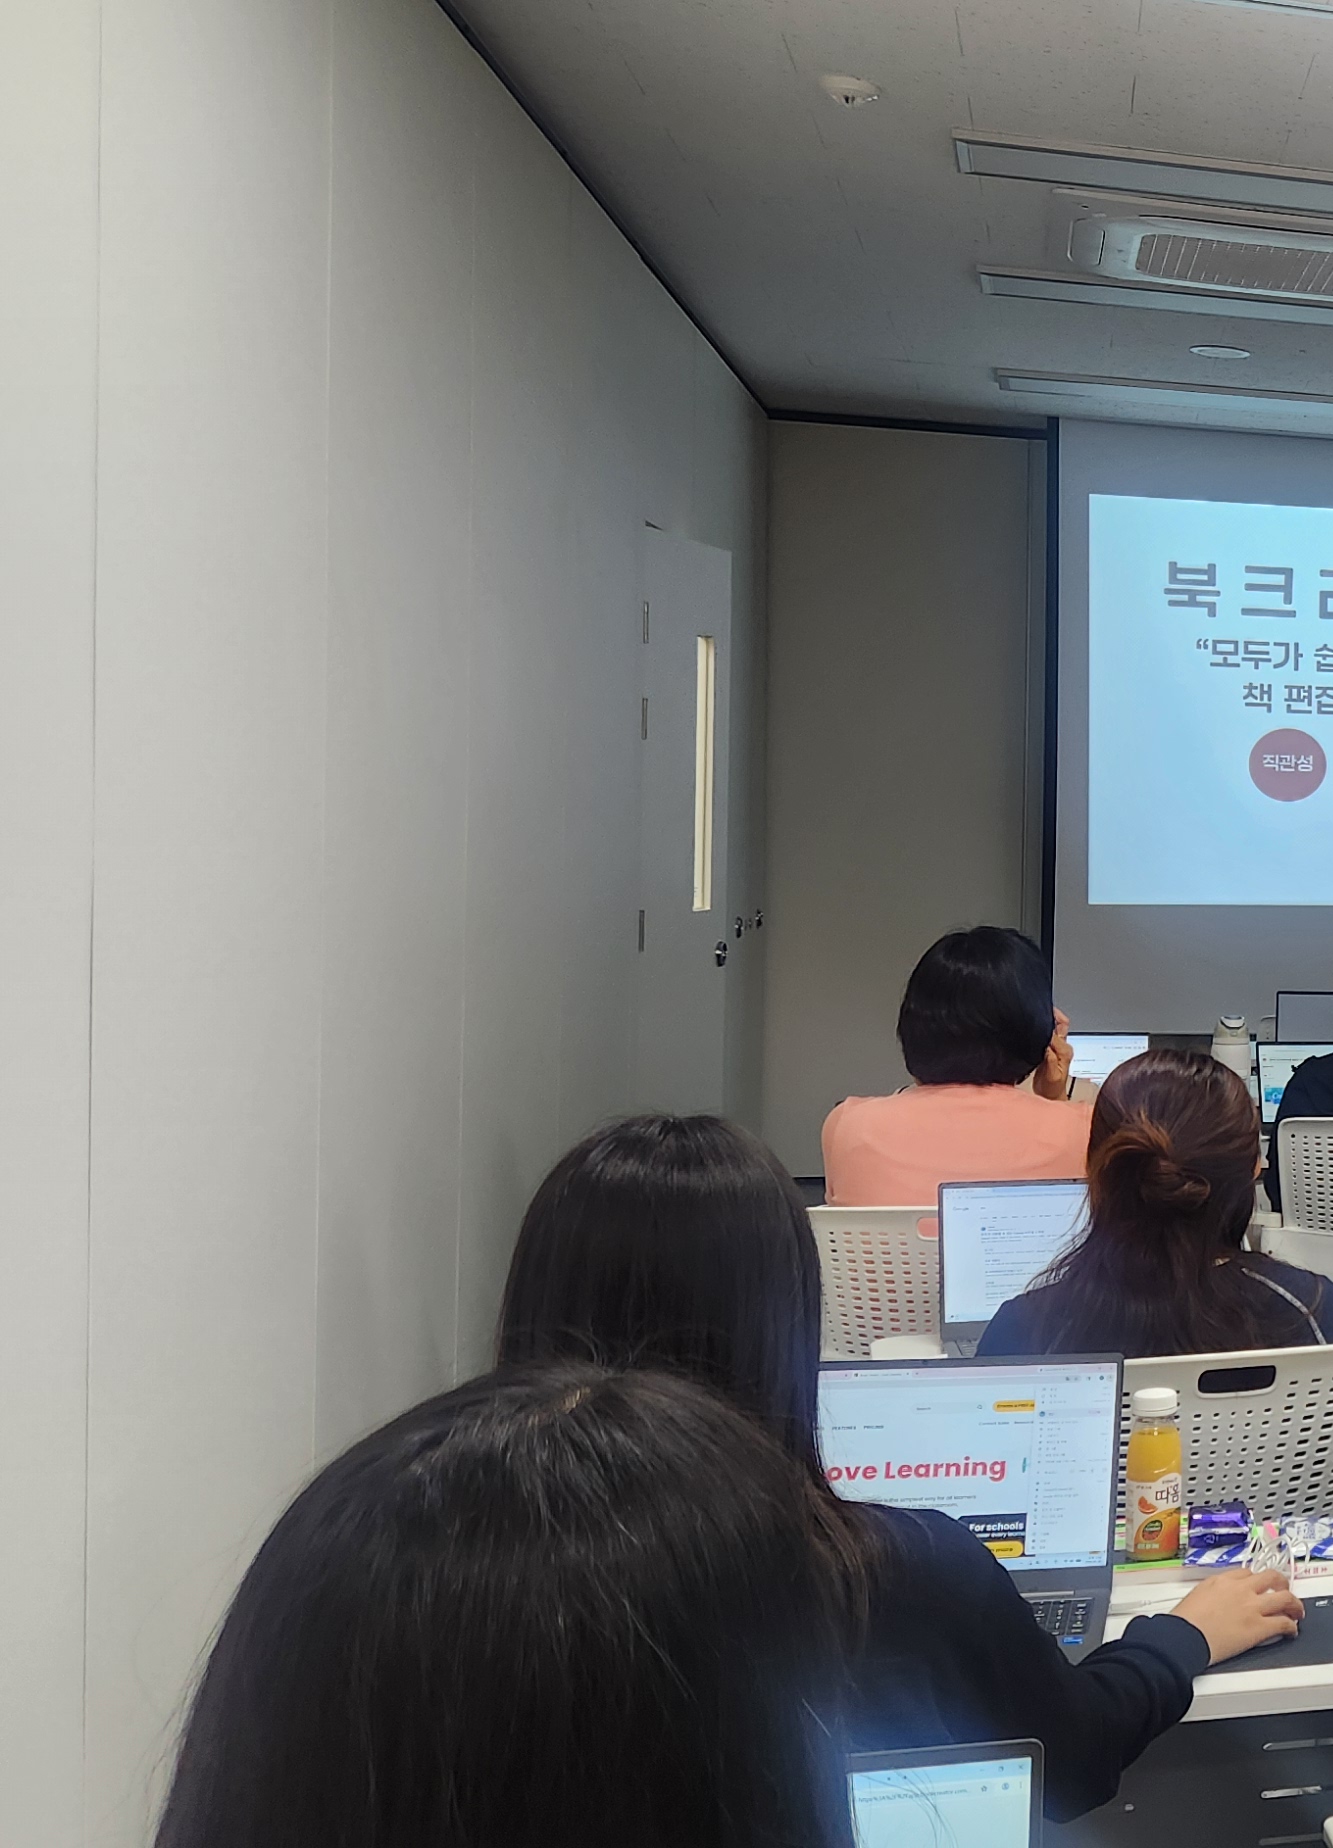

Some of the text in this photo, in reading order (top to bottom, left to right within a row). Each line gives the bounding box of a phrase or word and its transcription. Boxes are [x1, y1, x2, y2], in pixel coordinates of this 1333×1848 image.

[1242, 682, 1272, 713] 책
[1262, 754, 1314, 772] 직관성
[825, 1456, 1007, 1483] ove Learning
[1155, 1483, 1180, 1504] 따옴
[969, 1521, 1024, 1532] For schools
